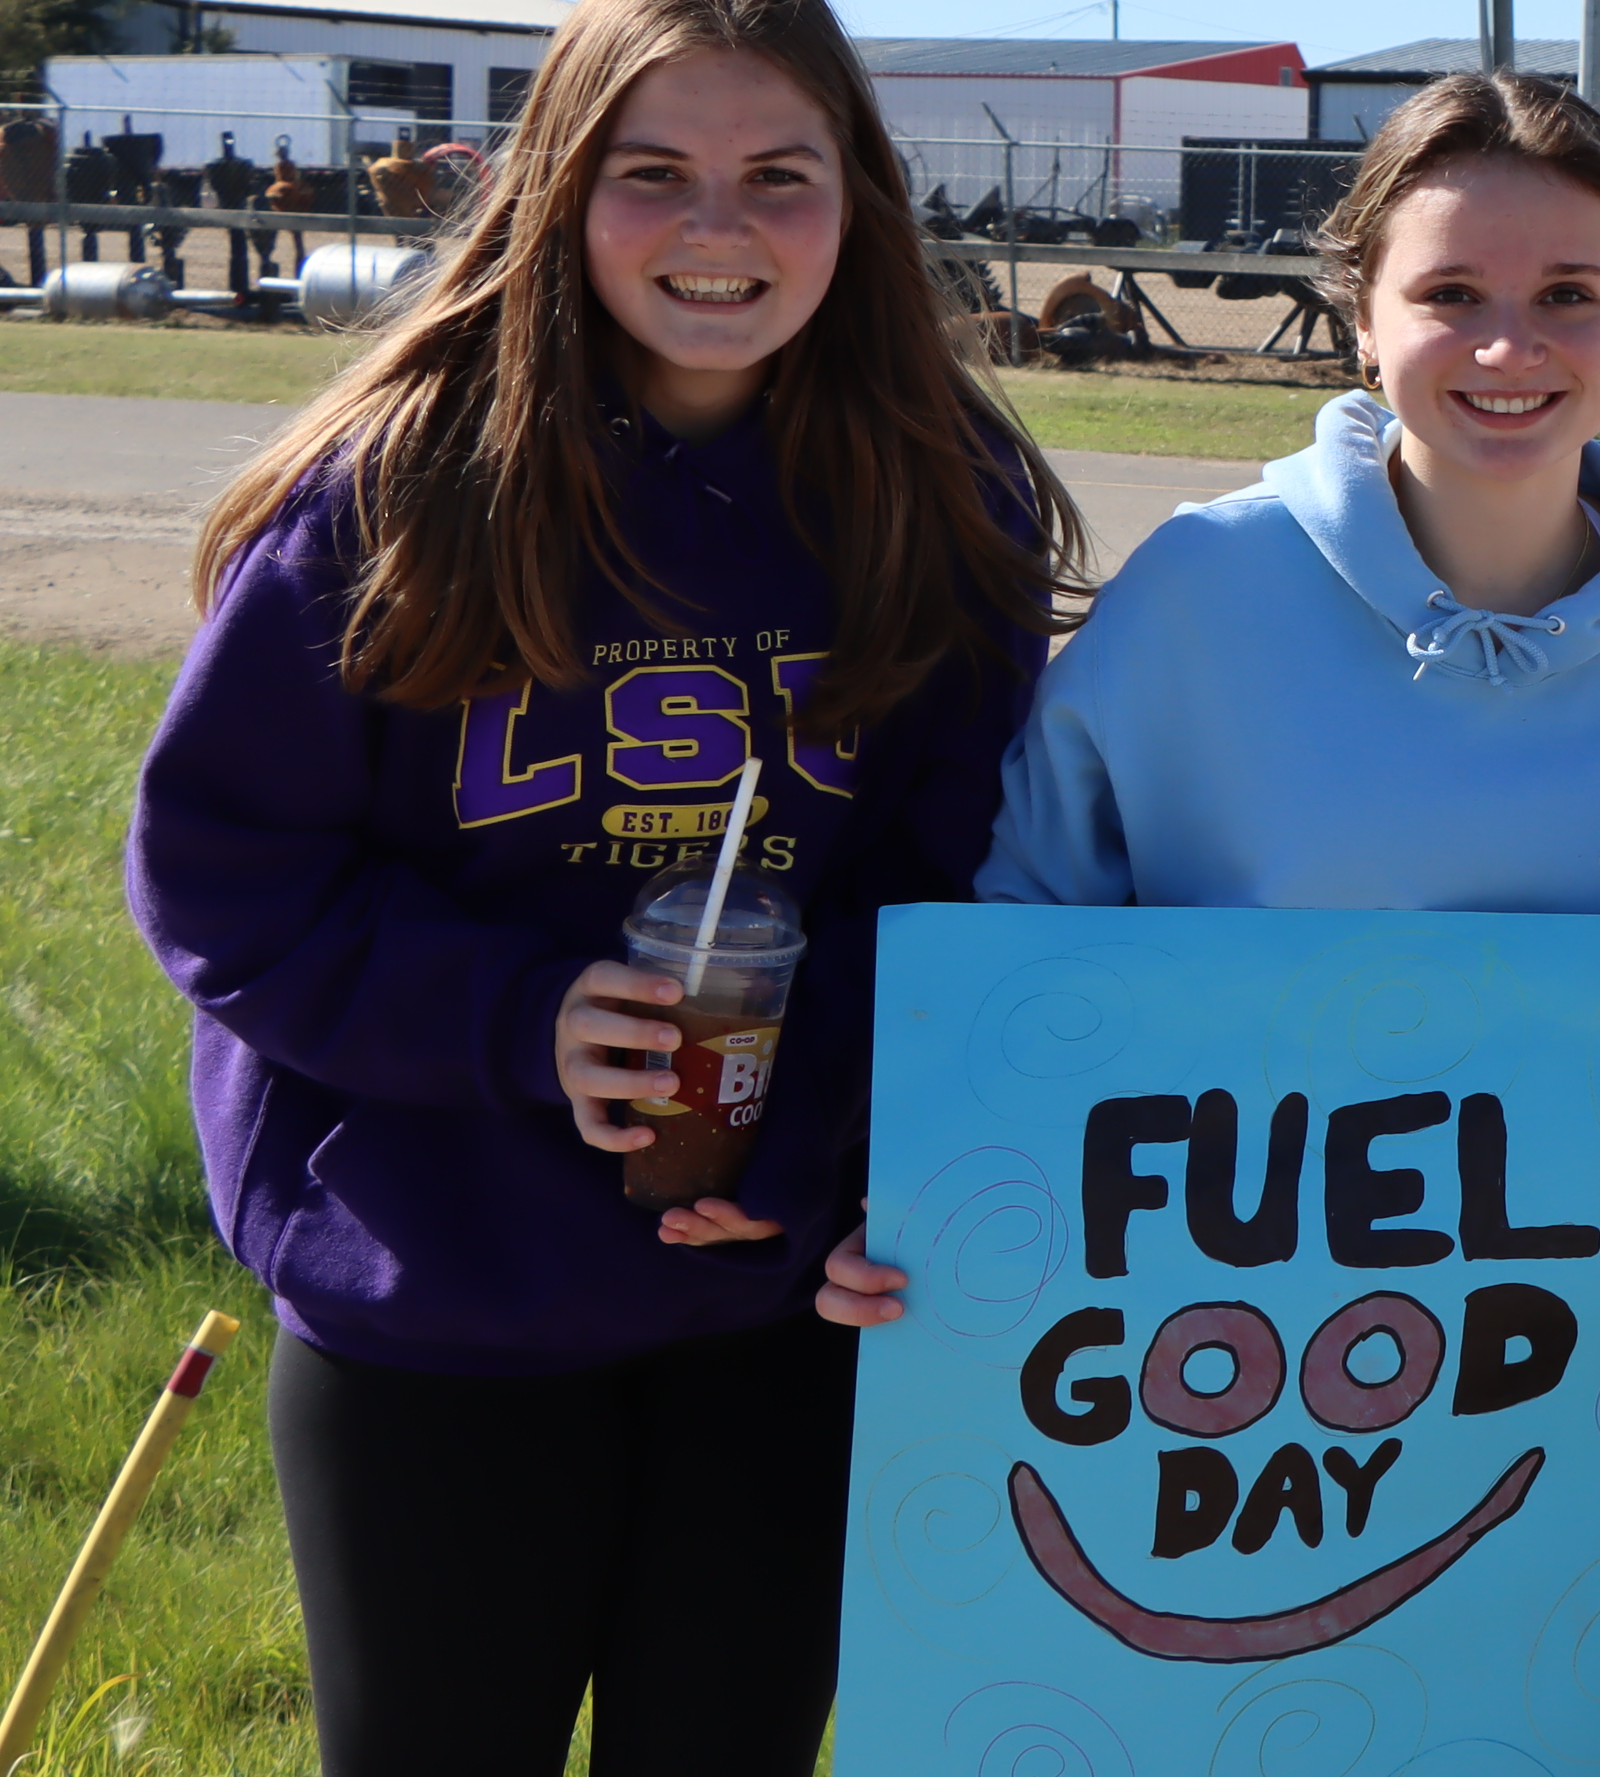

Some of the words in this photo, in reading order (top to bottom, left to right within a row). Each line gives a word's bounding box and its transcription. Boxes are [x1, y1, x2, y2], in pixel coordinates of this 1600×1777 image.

[592, 636, 737, 666] PROPERTY
[756, 630, 790, 651] OF
[452, 650, 858, 829] LSU
[622, 811, 680, 834] EST.
[696, 808, 753, 834] 18
[717, 1039, 774, 1105] Bi
[729, 1036, 756, 1045] CO-OP
[1019, 1282, 1578, 1447] GOOD
[1150, 1436, 1403, 1560] DAY
